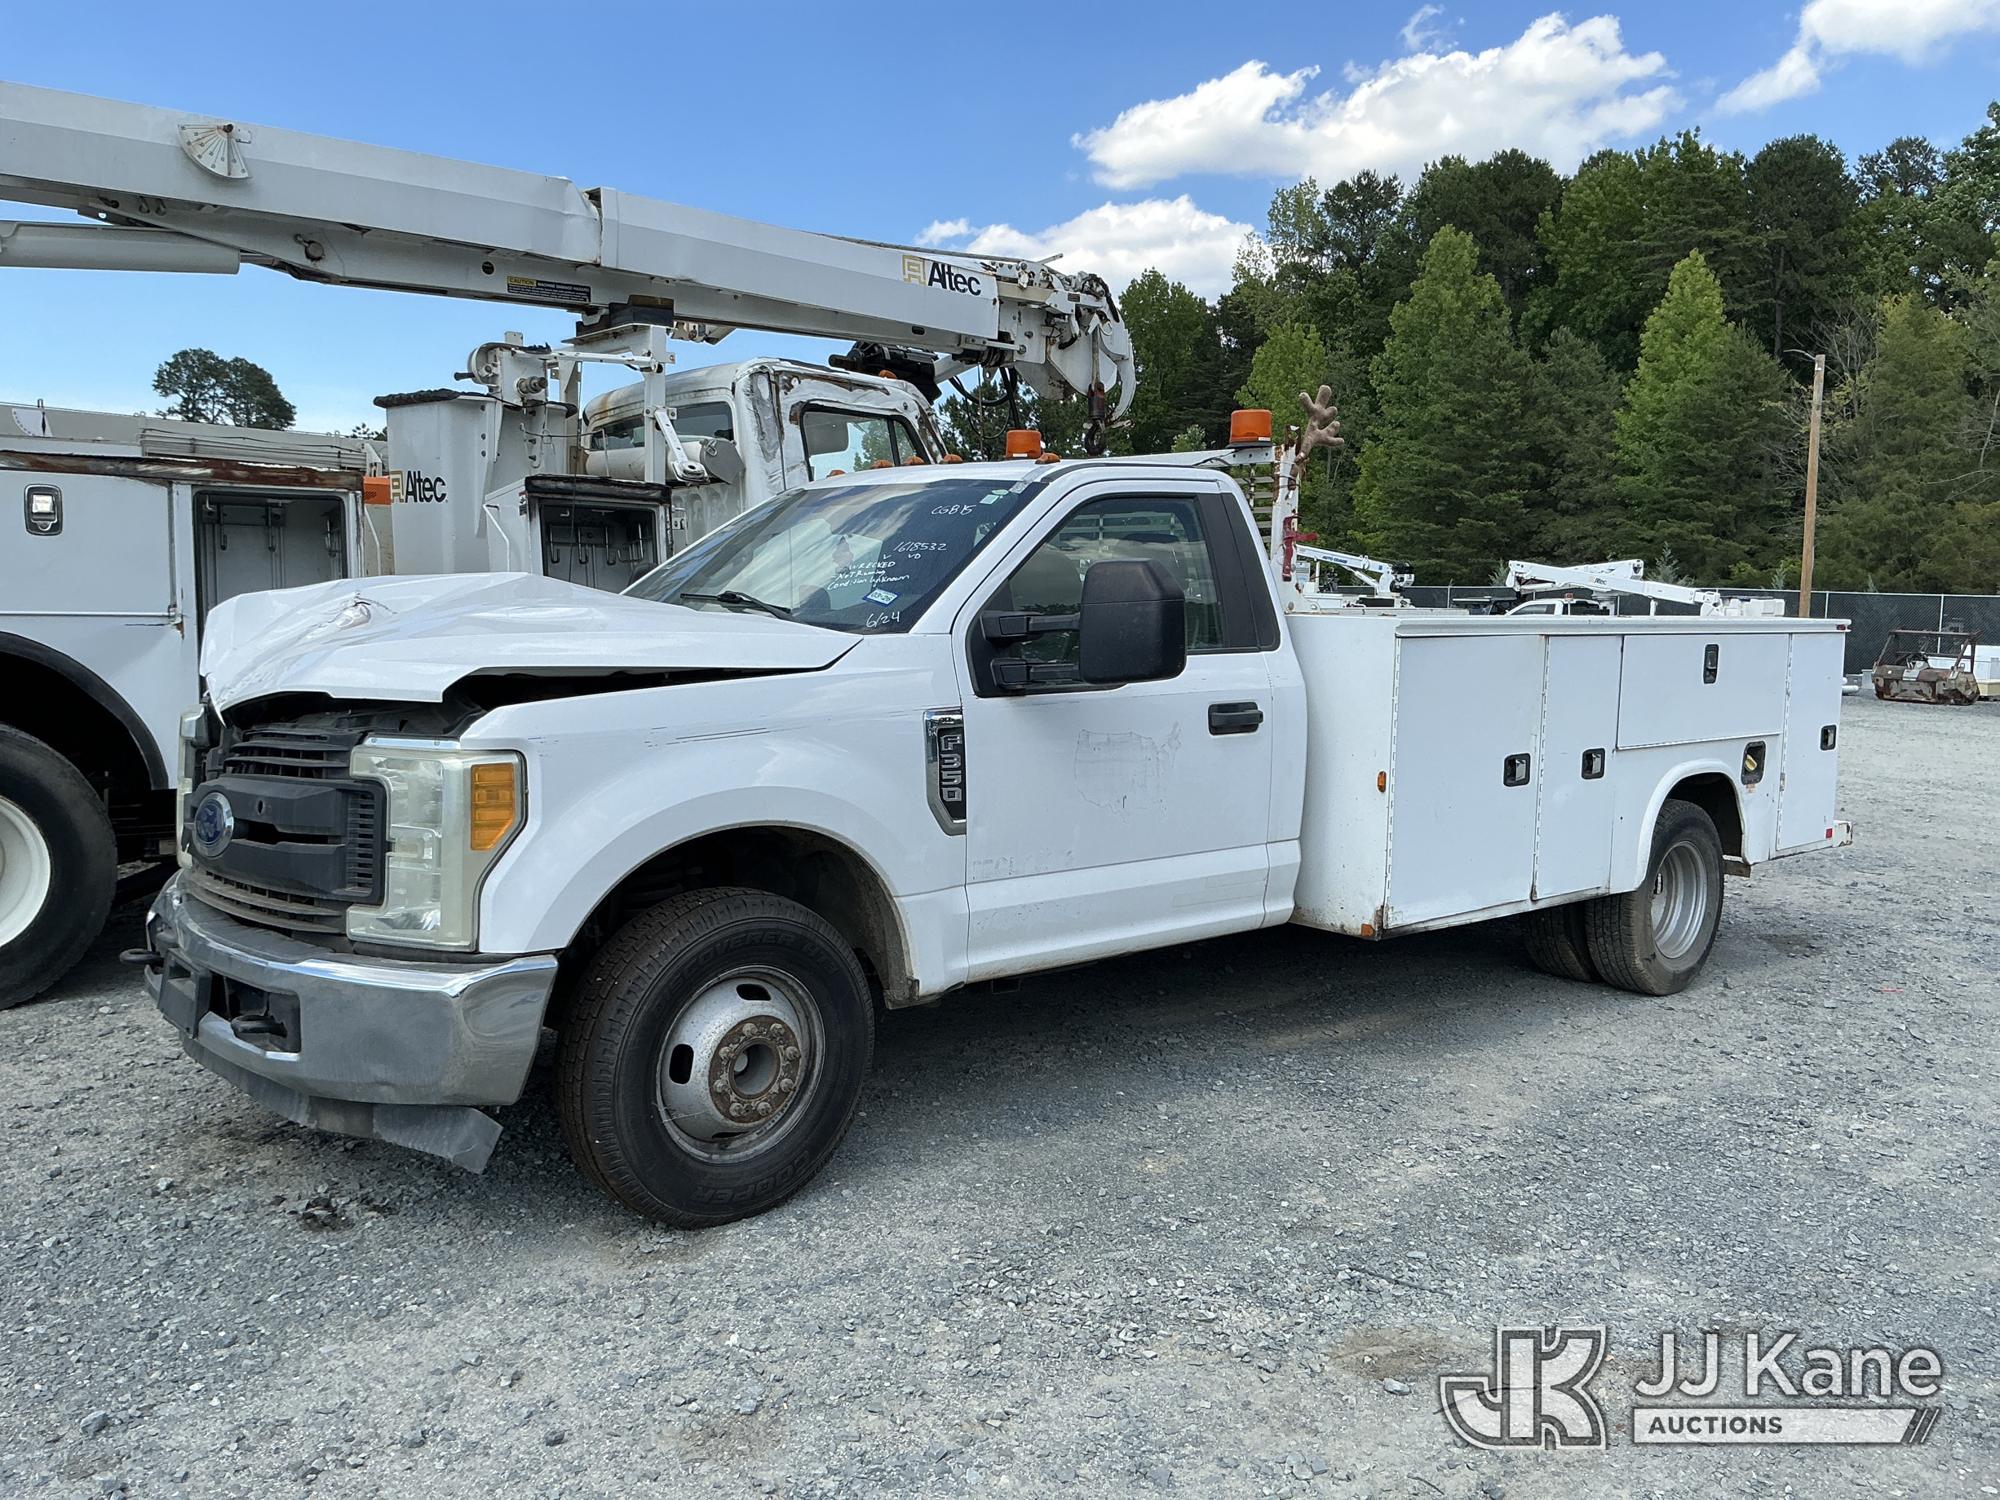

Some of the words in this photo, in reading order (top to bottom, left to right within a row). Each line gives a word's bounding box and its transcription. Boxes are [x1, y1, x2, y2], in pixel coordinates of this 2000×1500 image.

[927, 261, 982, 296] Altec
[404, 470, 448, 504] Altec
[893, 541, 948, 553] 1618532
[865, 611, 900, 628] 6/24
